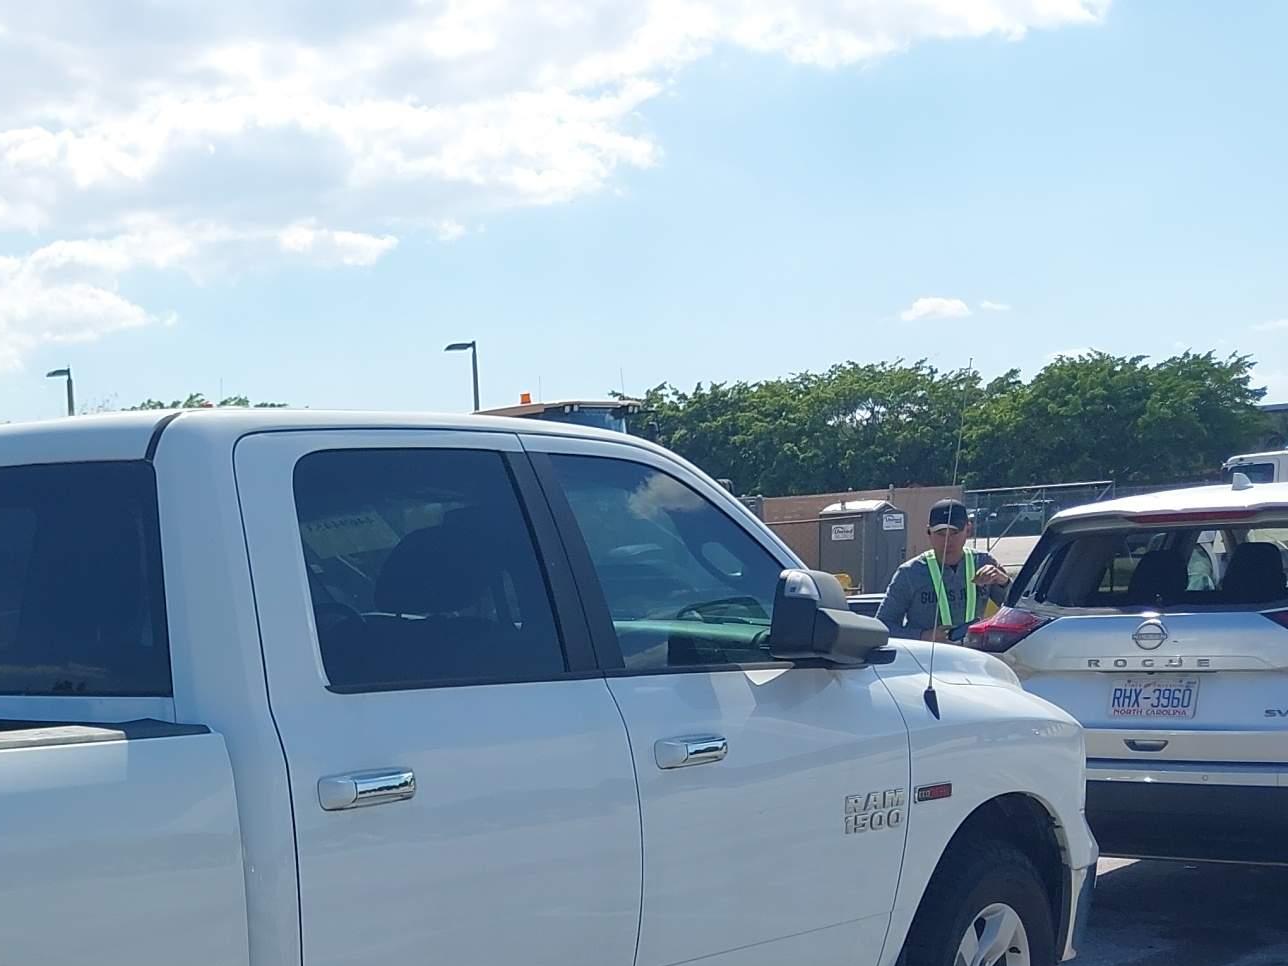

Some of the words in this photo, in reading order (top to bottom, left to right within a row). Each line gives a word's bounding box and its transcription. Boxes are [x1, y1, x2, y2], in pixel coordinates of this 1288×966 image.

[920, 588, 956, 604] GUS
[1087, 657, 1211, 668] ROGUE
[1112, 687, 1192, 708] RHX-3960
[1113, 709, 1142, 717] NORTH
[1145, 708, 1187, 717] CAROLINA
[844, 787, 904, 814] RAM
[844, 808, 903, 834] 1500
